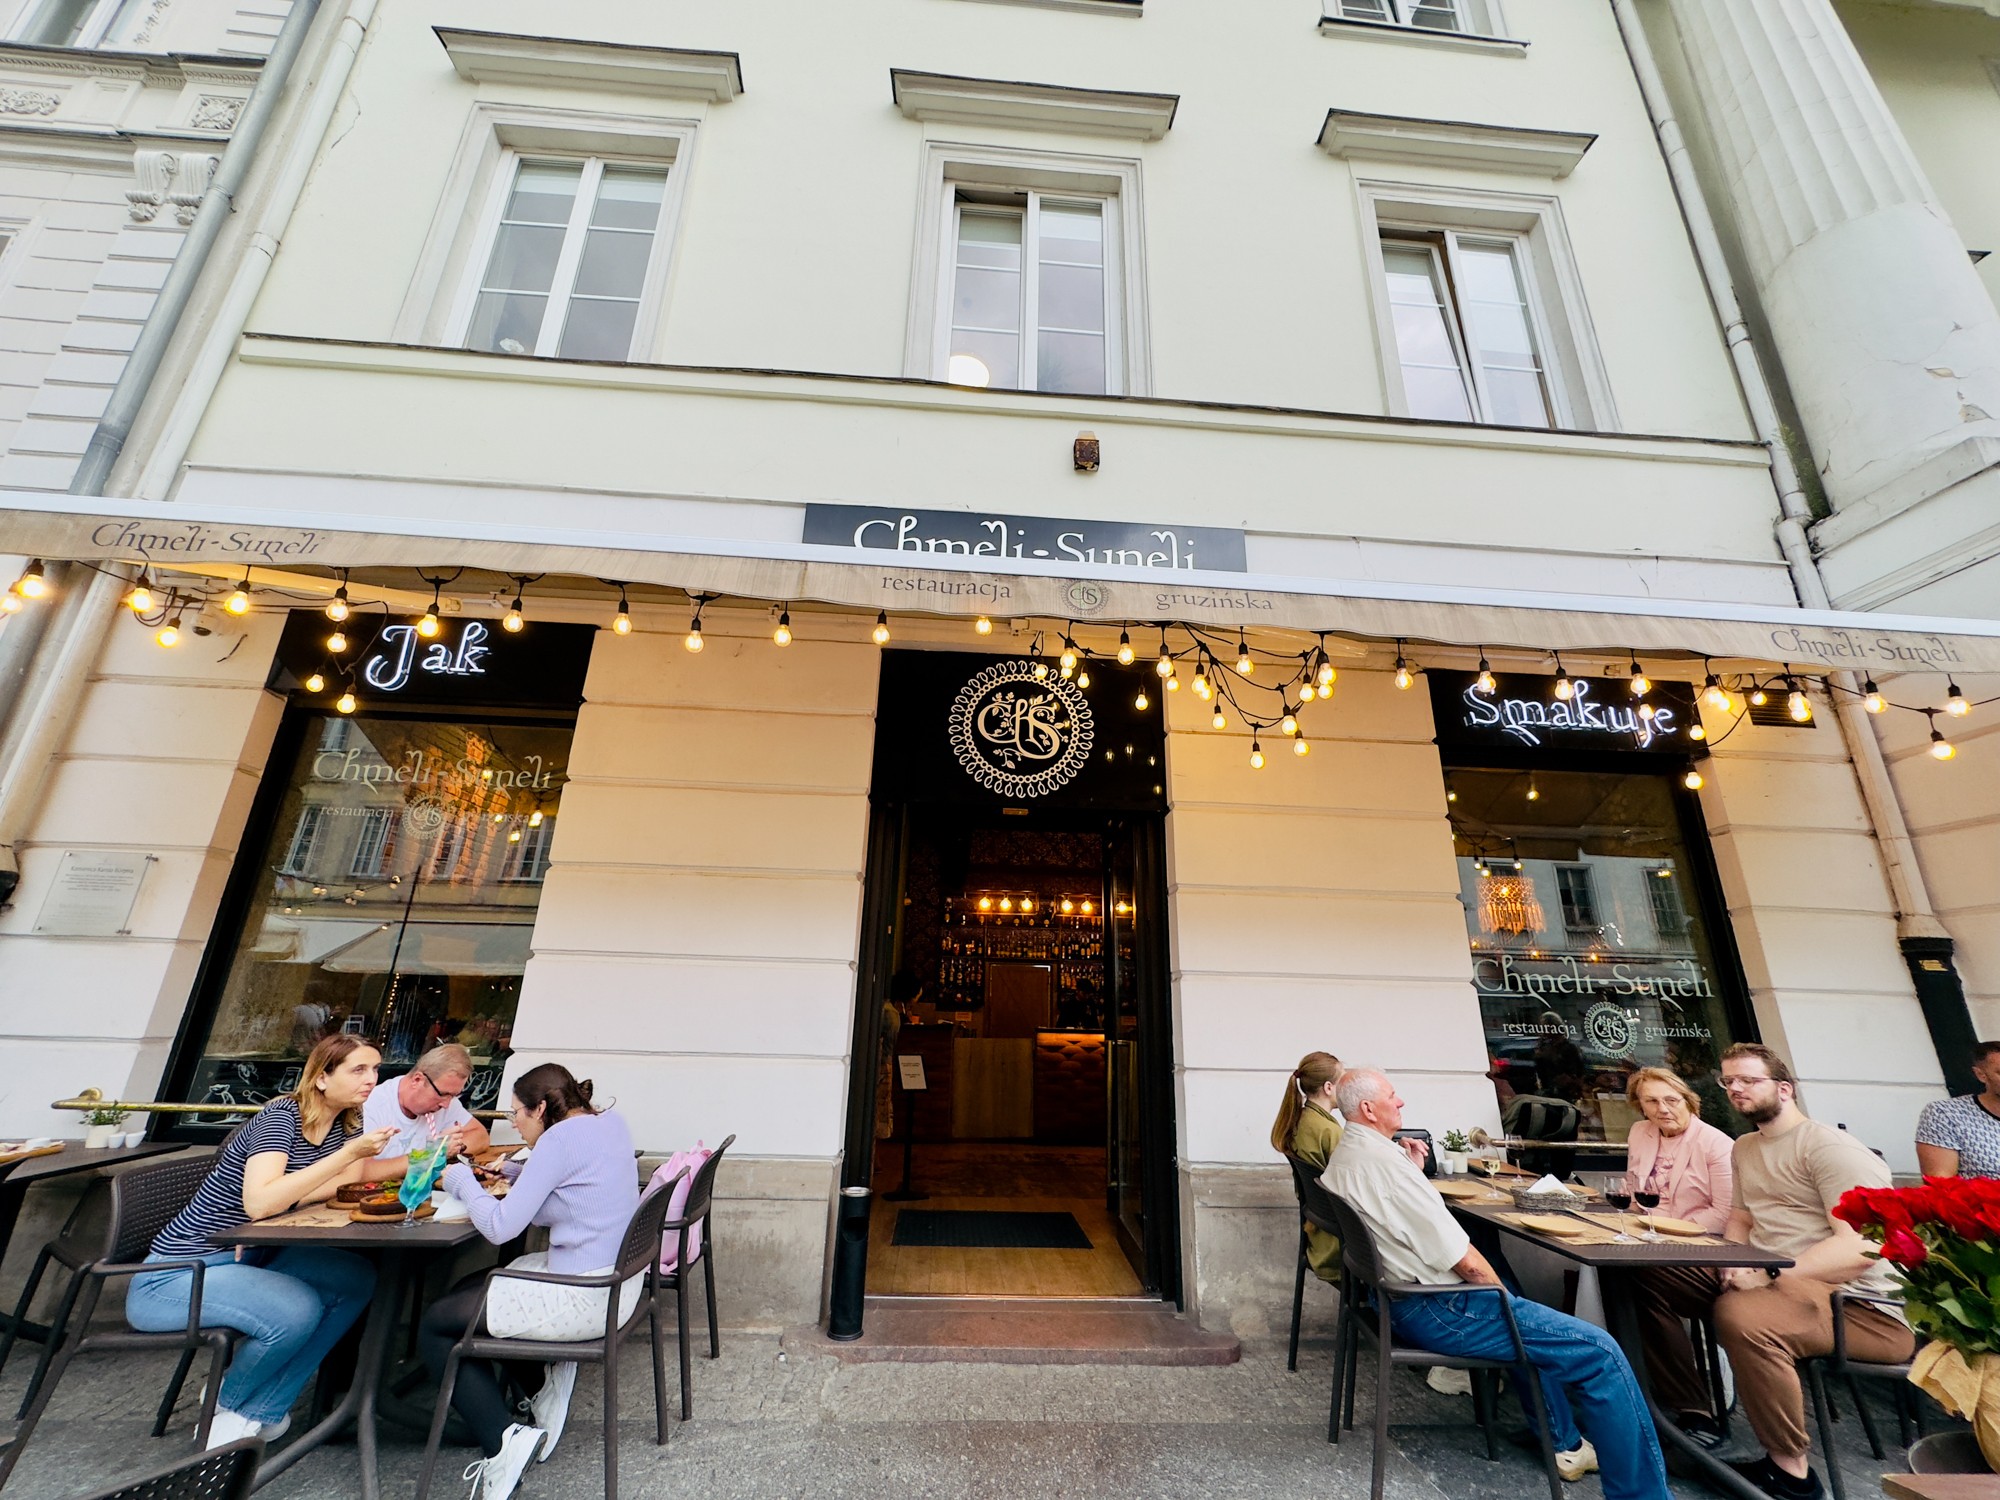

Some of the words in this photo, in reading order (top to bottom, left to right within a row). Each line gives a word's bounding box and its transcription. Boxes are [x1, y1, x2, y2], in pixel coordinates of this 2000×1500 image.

[91, 521, 326, 563] Chmeli-Suneli
[854, 515, 1195, 570] Chmeli-Suneli
[881, 575, 1012, 603] restauracja
[1156, 591, 1274, 611] gruzińska
[365, 622, 492, 691] Jak
[1770, 628, 1965, 671] Chmeli-Suneli
[1464, 680, 1678, 749] Smakuje
[320, 805, 394, 822] restauracja
[1473, 955, 1716, 1012] Chmeli-Suneli
[1502, 1020, 1578, 1040] restauracja
[1644, 1022, 1712, 1041] gruzińska
